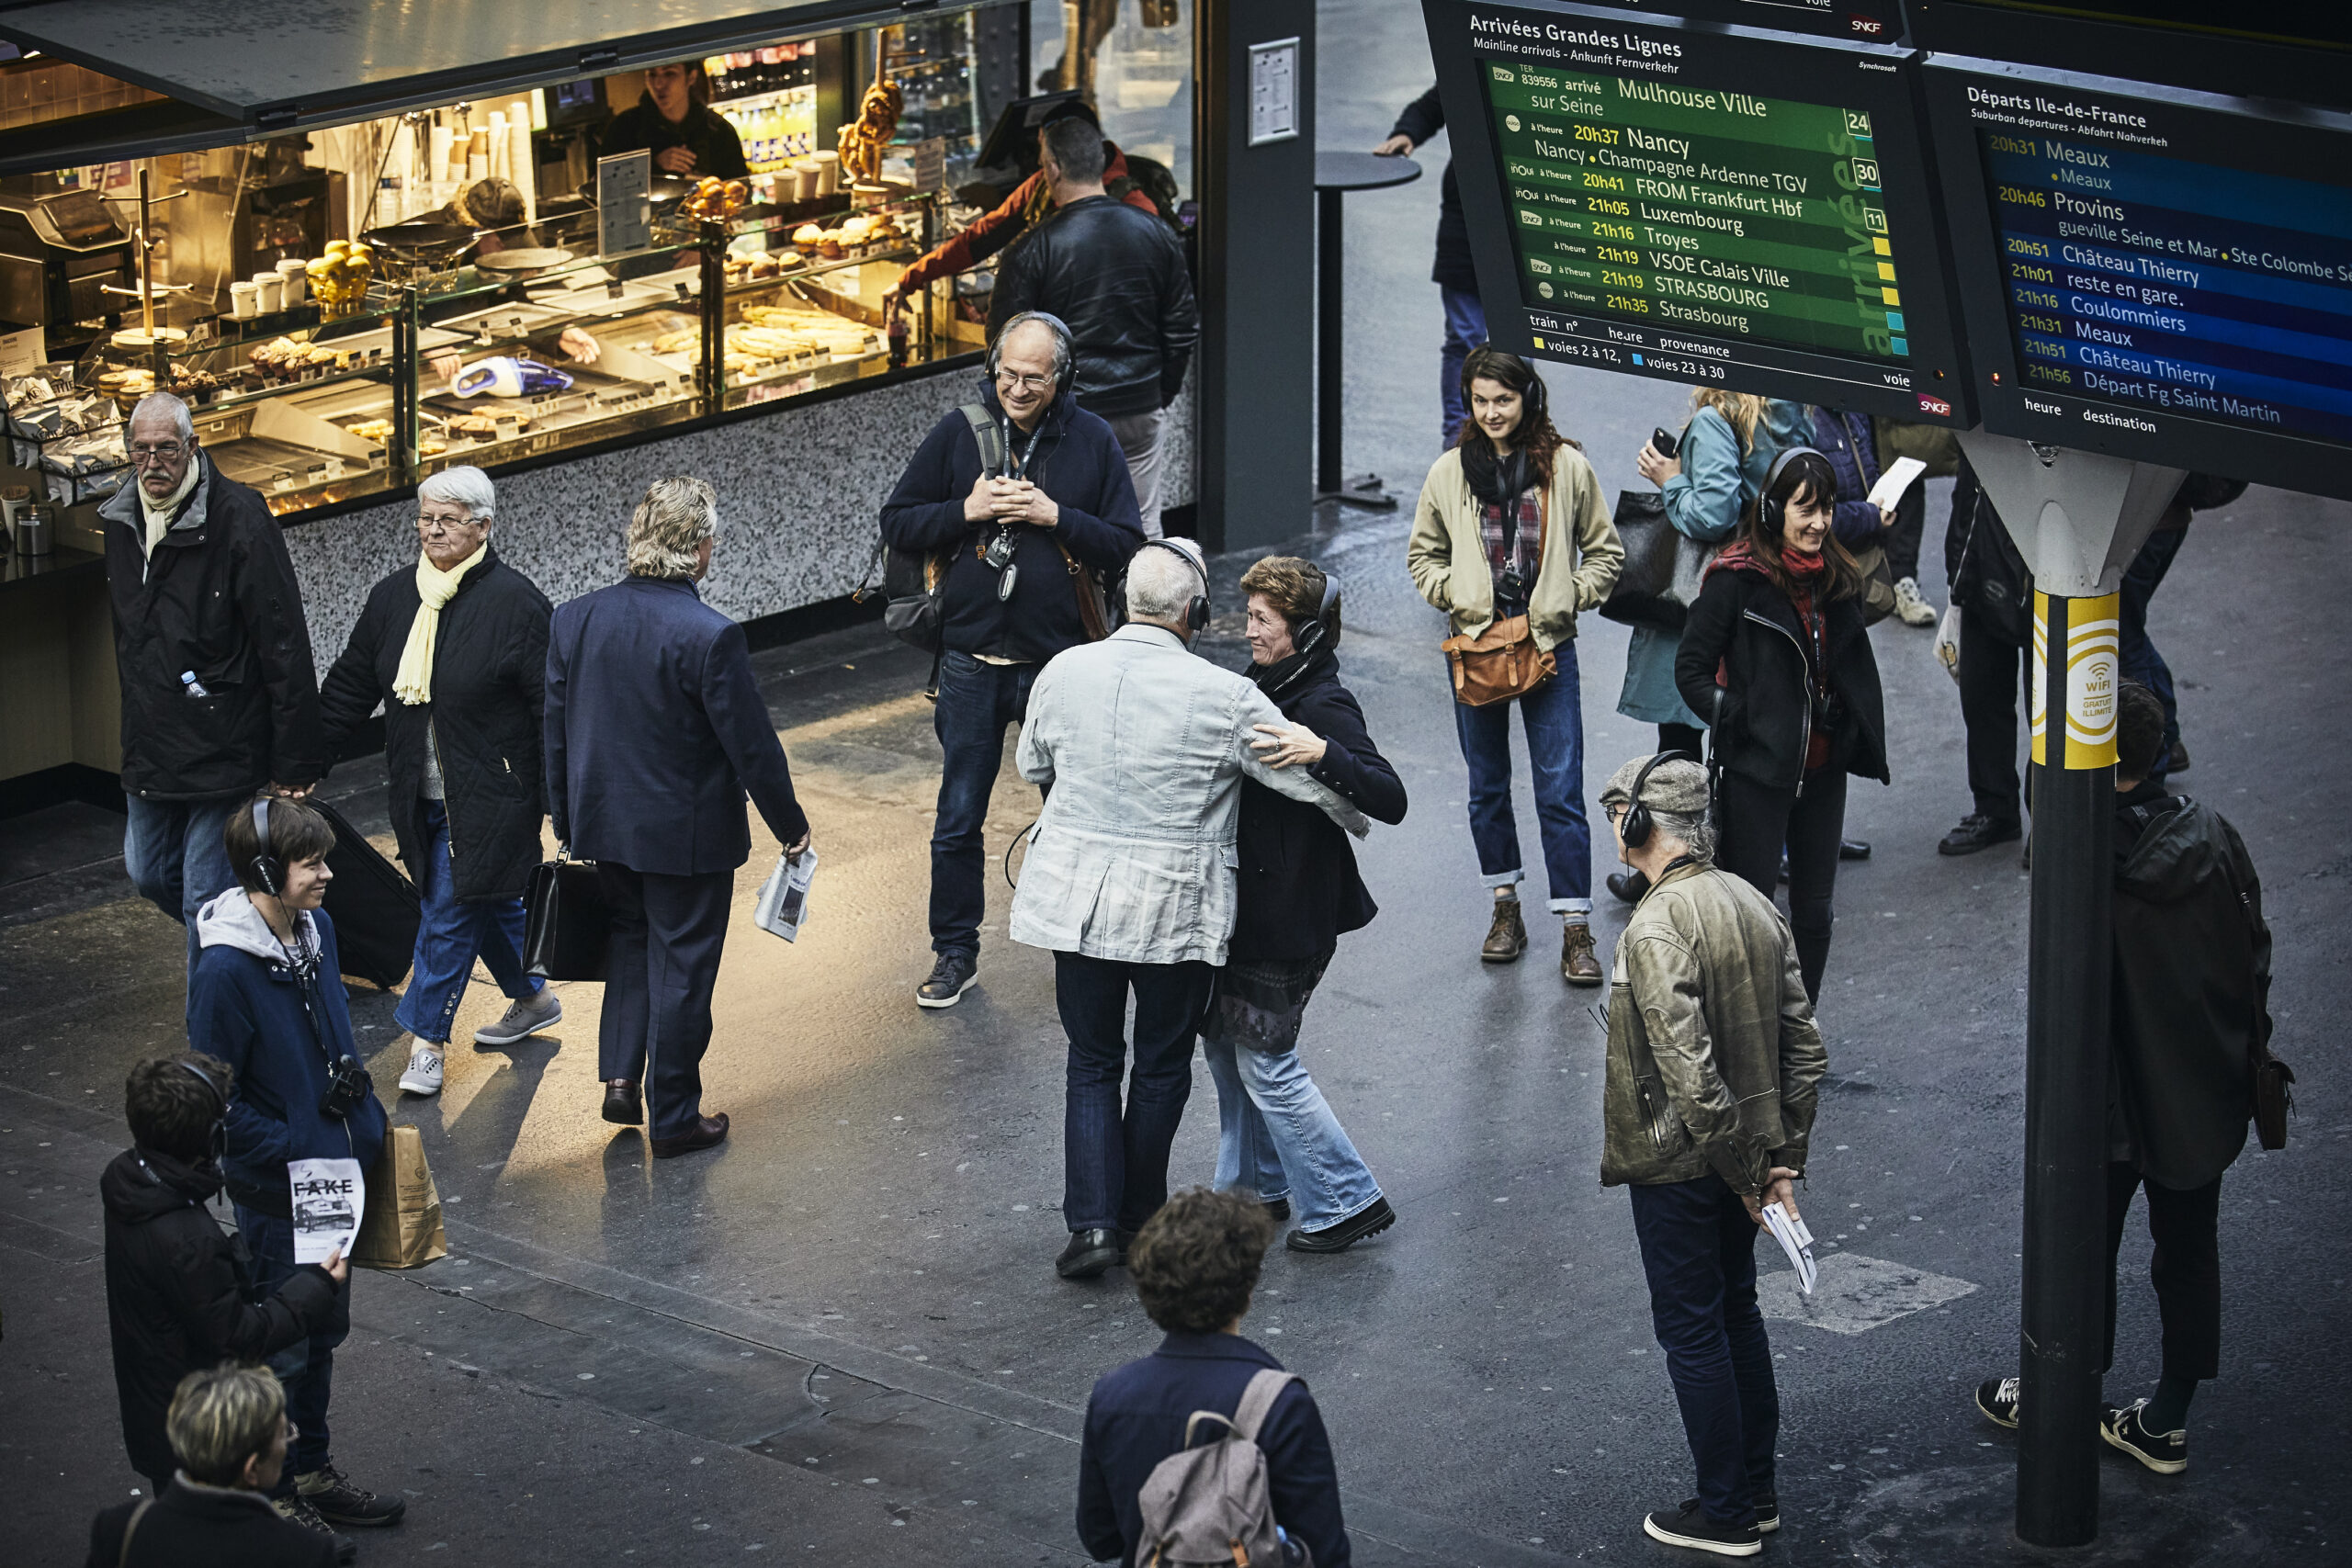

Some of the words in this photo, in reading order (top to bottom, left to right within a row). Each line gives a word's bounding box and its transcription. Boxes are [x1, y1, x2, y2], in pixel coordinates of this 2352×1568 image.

[1470, 15, 1541, 38] Arrivées
[1546, 24, 1619, 48] Grandes
[1624, 34, 1682, 57] Lignes
[1852, 20, 1882, 33] SNCF
[1474, 38, 1519, 53] Mainline
[1521, 45, 1560, 58] arrivals
[1570, 50, 1613, 65] Ankunft
[1616, 56, 1679, 74] Fernverkehr
[1520, 64, 1534, 73] TER
[1495, 72, 1513, 80] SNCF
[1521, 74, 1558, 89] 839556
[1565, 80, 1602, 95] arrivé
[1617, 78, 1716, 110] Mulhouse
[1720, 91, 1766, 117] Ville
[1848, 113, 1868, 131] 24
[1532, 96, 1555, 109] sur
[1560, 96, 1604, 116] Seine
[1967, 87, 2031, 110] Départs
[2035, 97, 2147, 128] Ile-de-France
[1971, 108, 2016, 123] Suburban
[2018, 116, 2069, 132] departures
[2077, 125, 2114, 138] Abfahrt
[2116, 131, 2168, 147] Nahverkeh
[1531, 123, 1536, 131] à
[1537, 124, 1563, 135] l'heure
[1574, 125, 1619, 146] 20h37
[1627, 128, 1689, 160] Nancy
[1857, 165, 1877, 181] 30
[1534, 139, 1585, 165] Nancy
[1599, 149, 1695, 179] Champagne
[1700, 164, 1769, 188] Ardenne
[1772, 174, 1807, 193] TGV
[1990, 135, 2036, 156] 20h31
[2046, 141, 2110, 169] Meaux
[1546, 170, 1572, 181] l'heure
[1583, 172, 1625, 192] 20h41
[1636, 178, 1687, 201] FROM
[1690, 186, 1769, 213] Frankfurt
[1772, 198, 1803, 218] Hbf
[2061, 168, 2112, 191] Meaux
[1523, 215, 1541, 224] SNCF
[1544, 193, 1549, 202] à
[1551, 194, 1577, 205] l'heure
[1588, 197, 1630, 216] 21h05
[1641, 203, 1744, 237] Luxembourg
[1868, 213, 1883, 227] 11
[1999, 186, 2046, 208] 20h46
[2054, 192, 2125, 221] Provins
[1549, 217, 1554, 226] à
[1555, 218, 1582, 229] l'heure
[1592, 221, 1635, 241] 21h16
[1645, 226, 1699, 251] Troyes
[2058, 221, 2117, 241] gueville
[2121, 228, 2164, 249] Seine
[2168, 240, 2185, 254] et
[2188, 240, 2218, 259] Mar
[2231, 247, 2258, 266] Ste
[2262, 253, 2334, 279] Colombe
[1533, 264, 1550, 272] SNCF
[1554, 241, 1559, 249] à
[1560, 243, 1586, 254] l'heure
[1597, 246, 1639, 265] 21h19
[1649, 251, 1697, 274] VSOE
[1700, 259, 1749, 282] Calais
[1751, 266, 1790, 288] Ville
[2008, 238, 2050, 258] 20h51
[2062, 245, 2134, 273] Château
[2138, 257, 2199, 288] Thierry
[1559, 265, 1564, 274] à
[1565, 267, 1591, 278] l'heure
[1602, 270, 1644, 289] 21h19
[1655, 276, 1770, 309] STRASBOURG
[2012, 263, 2053, 283] 21h01
[2067, 274, 2110, 293] reste
[2115, 284, 2136, 298] en
[2142, 288, 2184, 306] gare.
[1570, 291, 1596, 302] l'heure
[1606, 294, 1649, 313] 21h35
[1659, 300, 1749, 333] Strasbourg
[2016, 288, 2058, 309] 21h16
[2071, 296, 2186, 332] Coulommiers
[2020, 314, 2062, 333] 21h31
[2076, 321, 2133, 347] Meaux
[1530, 314, 1558, 329] train
[1566, 321, 1578, 332] n°
[1609, 327, 1643, 343] heure
[1660, 338, 1730, 358] provenance
[1883, 373, 1911, 387] voie
[1548, 341, 1579, 355] voies
[1582, 345, 1589, 356] 2
[1592, 347, 1599, 359] à
[1602, 349, 1622, 364] 12,
[1647, 358, 1678, 372] voies
[1681, 361, 1696, 375] 23
[1700, 364, 1707, 376] à
[1710, 367, 1724, 379] 30
[2025, 339, 2066, 359] 21h51
[2080, 346, 2151, 374] Château
[2154, 360, 2215, 390] Thierry
[1920, 400, 1949, 414] SNCF
[2030, 364, 2071, 384] 21h56
[2084, 371, 2143, 397] Départ
[2148, 384, 2170, 406] Fg
[2173, 388, 2219, 412] Saint
[2223, 397, 2281, 423] Martin
[2025, 397, 2062, 416] heure
[2083, 410, 2157, 433] destination
[2083, 698, 2111, 708] GRATUIT
[294, 1179, 353, 1196] FAKE
